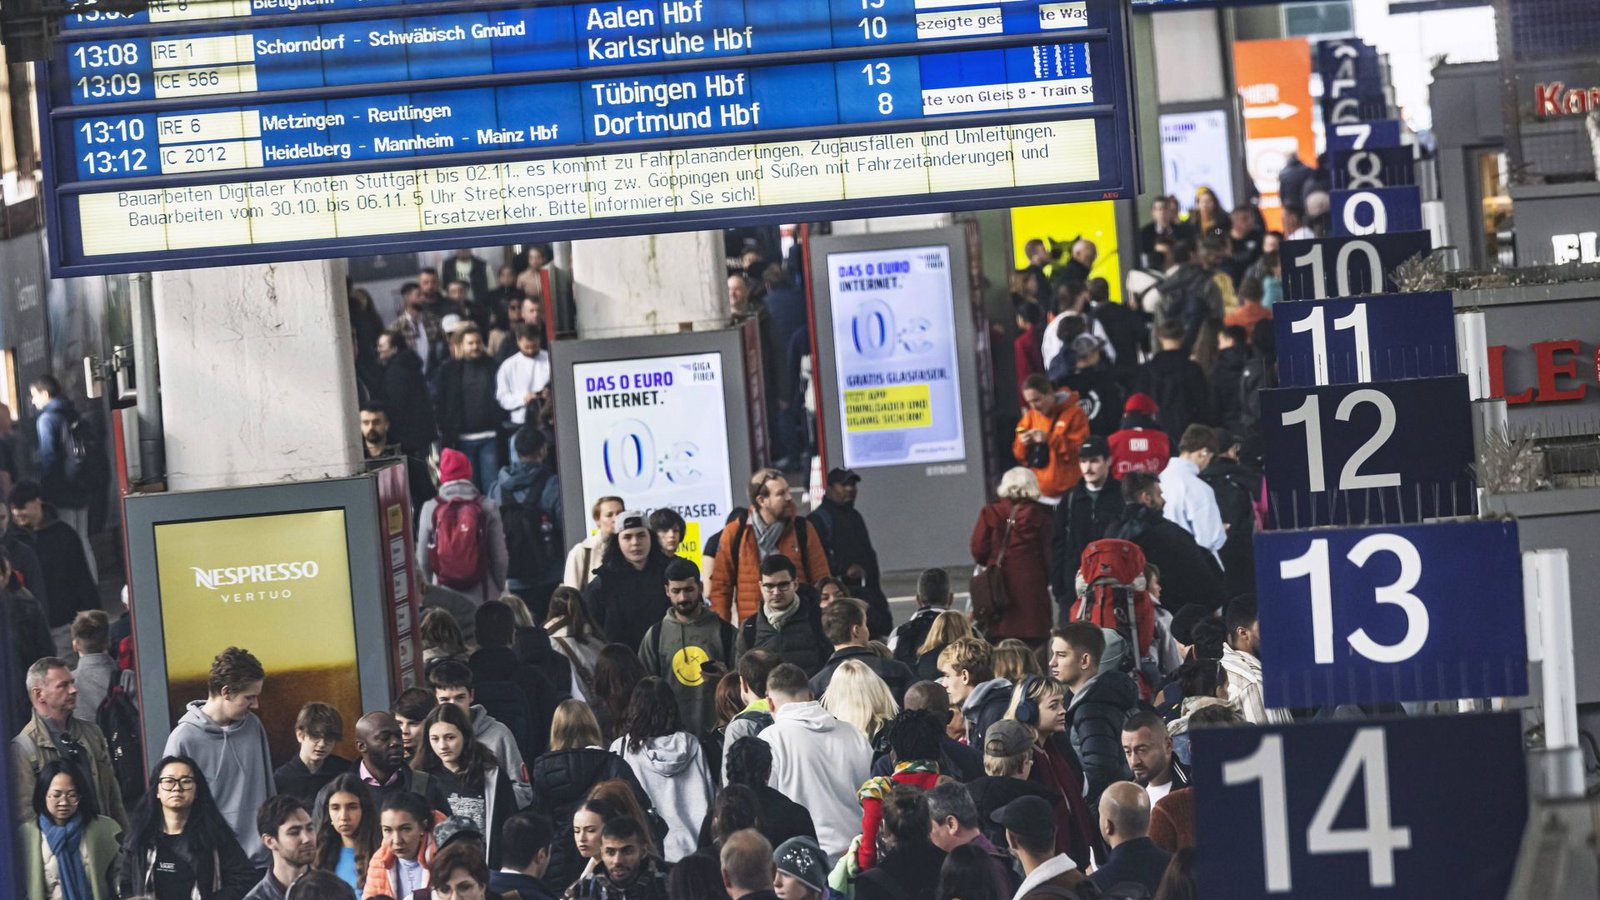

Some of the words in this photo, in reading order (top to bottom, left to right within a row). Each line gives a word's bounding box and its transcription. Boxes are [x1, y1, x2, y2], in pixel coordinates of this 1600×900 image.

[587, 6, 654, 30] Aalen
[664, 0, 703, 24] Hbf
[858, 16, 888, 40] 10
[154, 44, 178, 60] IRE
[186, 43, 194, 57] 1
[256, 34, 345, 56] Schorndorf
[369, 26, 465, 47] Schwäbisch
[472, 21, 526, 39] Gmünd
[588, 32, 704, 60] Karlsruhe
[713, 26, 752, 51] Hbf
[74, 43, 138, 68] 13:08
[77, 73, 141, 98] 13:09
[156, 74, 180, 90] ICE
[188, 71, 219, 87] 566
[861, 62, 891, 86] 13
[592, 81, 697, 108] Tübingen
[706, 73, 744, 98] Hbf
[878, 92, 894, 114] 8
[948, 93, 974, 105] von
[978, 89, 1014, 103] Gleis
[1018, 88, 1026, 99] 8
[1041, 85, 1076, 97] Train
[80, 118, 144, 144] 13:10
[160, 120, 183, 136] IRE
[190, 118, 200, 133] 6
[262, 113, 344, 131] Metzingen
[368, 105, 452, 123] Reutlingen
[594, 106, 712, 136] Dortmund
[720, 102, 760, 127] Hbf
[265, 143, 351, 160] Heidelberg
[374, 133, 454, 152] Mannheim
[476, 128, 524, 145] Mainz
[530, 124, 558, 142] Hbf
[1336, 124, 1371, 150] 7
[83, 148, 148, 174] 13:12
[118, 188, 212, 208] Bauarbeiten
[220, 182, 286, 202] Digitaler
[294, 178, 348, 195] Knoten
[355, 170, 429, 190] Stuttgart
[436, 168, 458, 184] bis
[526, 164, 545, 176] es
[552, 156, 607, 174] kommt
[616, 157, 633, 170] zu
[810, 134, 914, 158] Zugausfällen
[922, 130, 948, 147] und
[956, 126, 1056, 144] Umleitungen.
[162, 150, 178, 166] IC
[186, 146, 226, 164] 2012
[1348, 152, 1384, 190] 8
[128, 208, 223, 227] Bauarbeiten
[230, 206, 264, 220] vom
[271, 199, 320, 217] 30.10.
[326, 198, 350, 212] bis
[356, 193, 407, 210] 06.11.
[413, 190, 424, 206] 5
[430, 189, 456, 205] Uhr
[464, 180, 606, 202] Streckensperrung
[614, 178, 640, 191] zw.
[648, 171, 729, 189] Göppingen
[736, 166, 764, 181] und
[770, 162, 818, 179] Süßen
[826, 158, 849, 174] mit
[858, 150, 1014, 172] Fahrzeitänderungen
[1021, 144, 1049, 160] und
[424, 204, 542, 226] Ersatzverkehr.
[548, 200, 586, 216] Bitte
[594, 194, 683, 212] informieren
[690, 190, 714, 206] Sie
[721, 186, 756, 202] sich!
[1342, 192, 1388, 236] 9
[1295, 240, 1384, 300] 10
[1291, 303, 1372, 386] 11
[692, 362, 710, 372] GIGA
[586, 376, 616, 392] DAS
[634, 371, 674, 388] EURO
[588, 390, 664, 410] INTERNET.
[1282, 388, 1402, 492] 12
[189, 560, 320, 590] NESPRESSO
[220, 589, 292, 603] VERTUO
[1280, 532, 1430, 664] 13
[1222, 726, 1412, 893] 14
